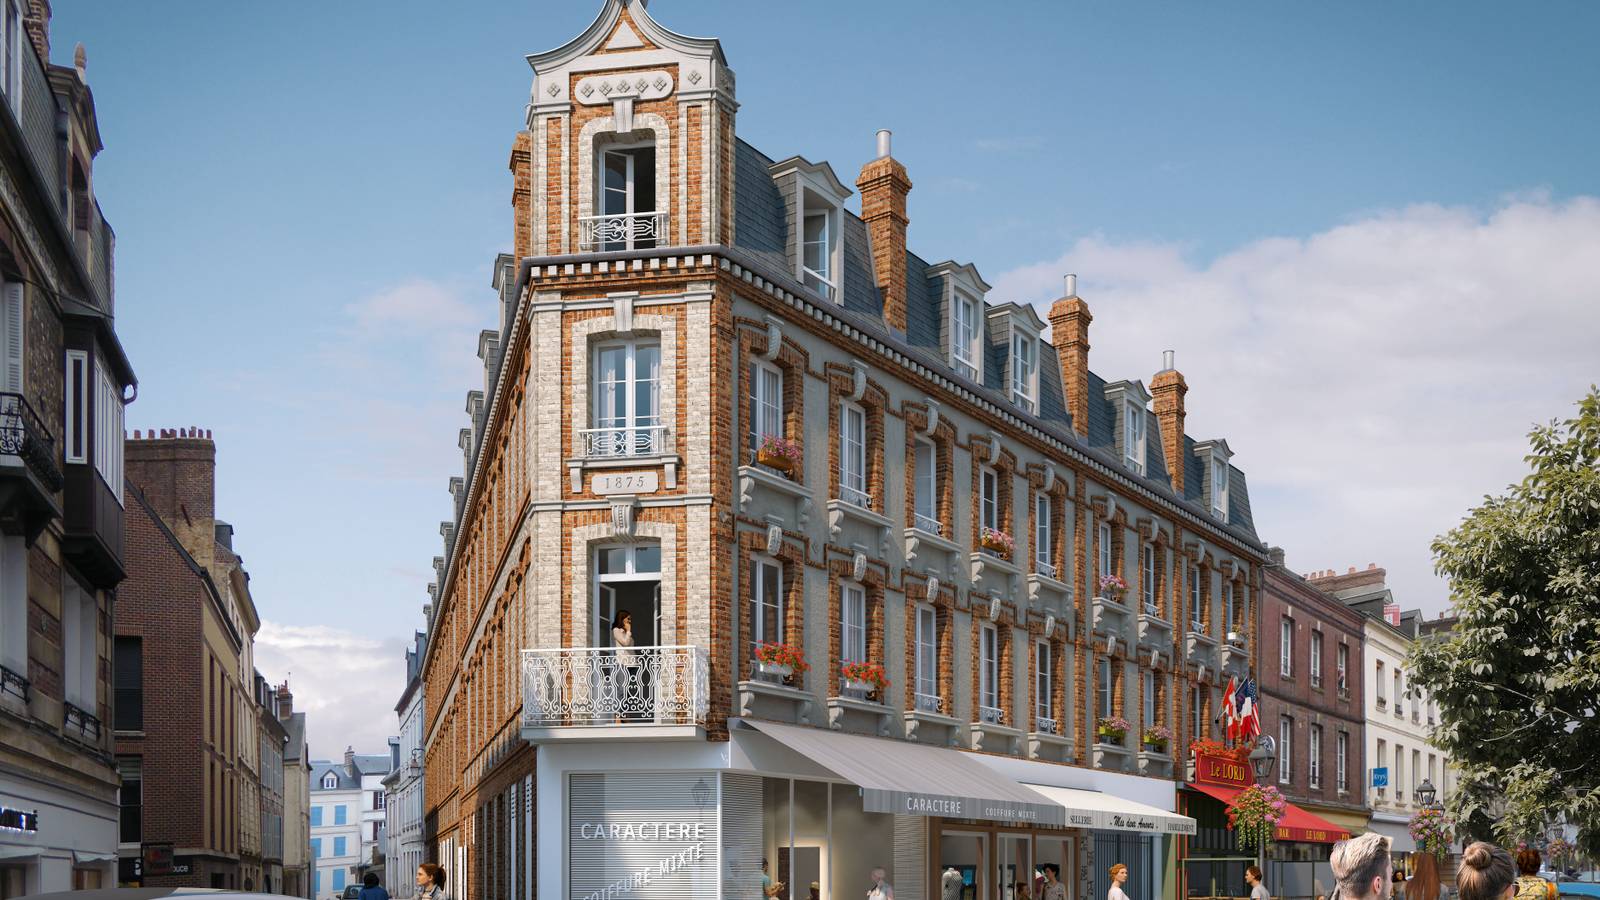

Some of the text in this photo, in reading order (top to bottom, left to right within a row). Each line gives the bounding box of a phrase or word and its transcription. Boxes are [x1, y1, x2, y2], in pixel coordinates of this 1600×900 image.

[606, 476, 644, 489] 1875
[1210, 762, 1245, 782] Le LORD
[907, 797, 961, 814] CARACTERE
[985, 807, 1015, 818] COIFFURE
[581, 823, 704, 839] CARACTERE
